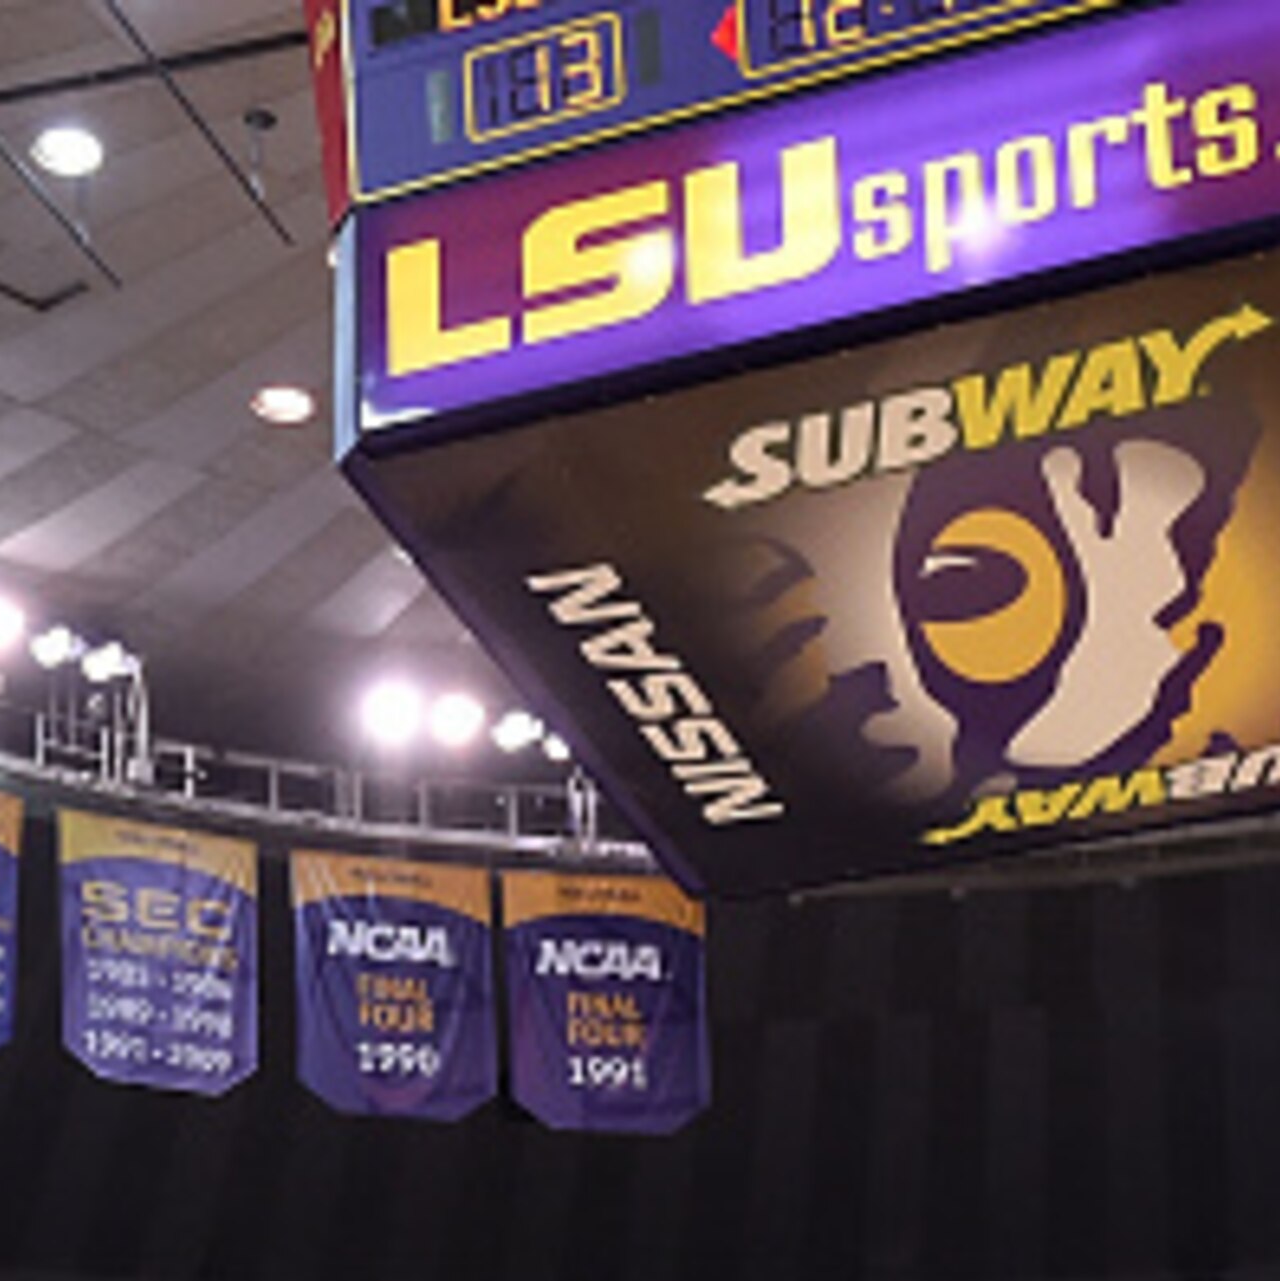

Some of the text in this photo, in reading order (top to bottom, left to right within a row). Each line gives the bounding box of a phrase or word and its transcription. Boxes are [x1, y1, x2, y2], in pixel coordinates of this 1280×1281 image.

[702, 304, 1274, 508] SUBWAY
[526, 562, 785, 827] NISSAN
[81, 880, 233, 943] SEC
[327, 920, 456, 968] NCAA
[534, 938, 663, 982] NCAA
[357, 973, 427, 1000] FINAL
[359, 1001, 433, 1033] FOUR
[567, 991, 642, 1020] FINAL
[567, 1020, 644, 1049] FOUR
[355, 1042, 440, 1077] 1990
[566, 1057, 648, 1090] 1991
